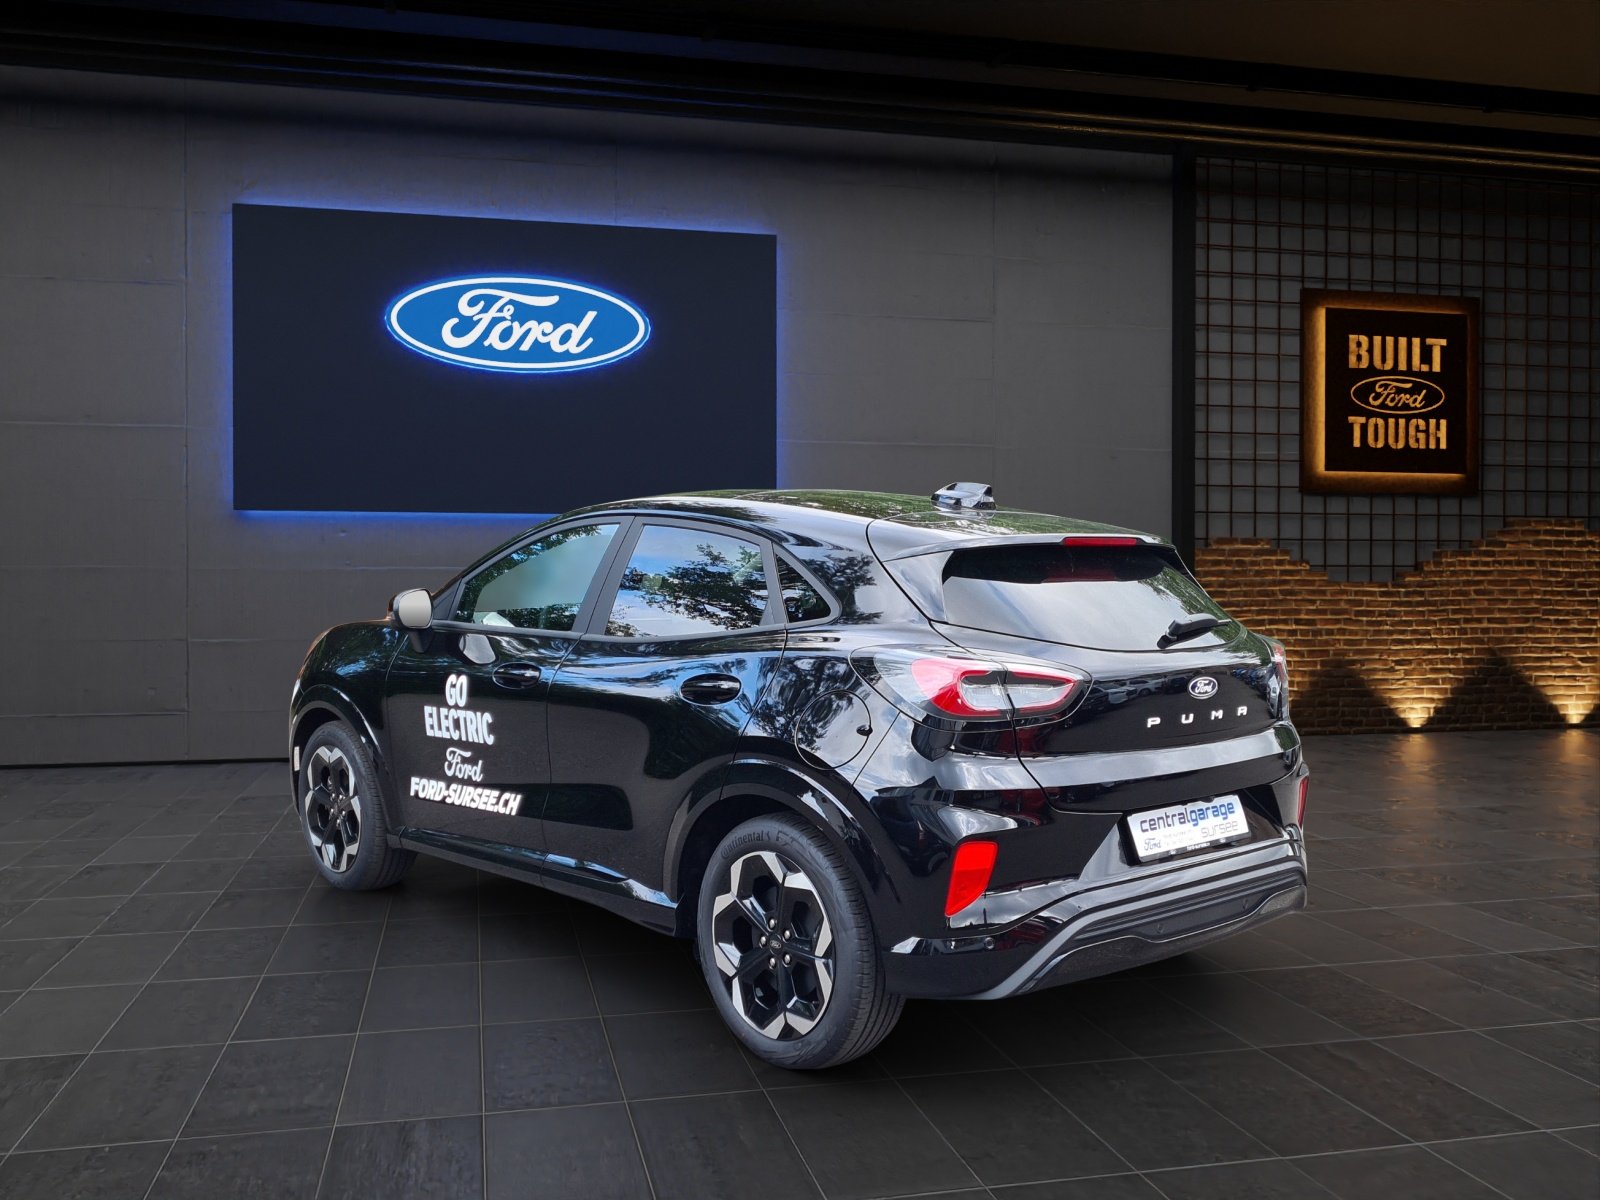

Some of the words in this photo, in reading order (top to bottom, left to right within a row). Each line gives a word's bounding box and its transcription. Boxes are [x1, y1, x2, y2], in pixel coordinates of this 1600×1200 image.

[441, 288, 597, 353] Ford
[1348, 334, 1447, 372] BUILT
[1369, 380, 1427, 408] Ford
[1348, 416, 1447, 449] TOUGH
[445, 674, 467, 707] GO
[1194, 680, 1213, 693] Ford
[423, 705, 494, 745] ELECTRIC
[1147, 706, 1247, 728] PUMA
[444, 747, 483, 782] Ford
[410, 776, 522, 816] FORD-SURSEE.CH
[1140, 802, 1235, 833] centralgarage
[1201, 820, 1239, 838] sursee
[1144, 838, 1161, 851] Ford
